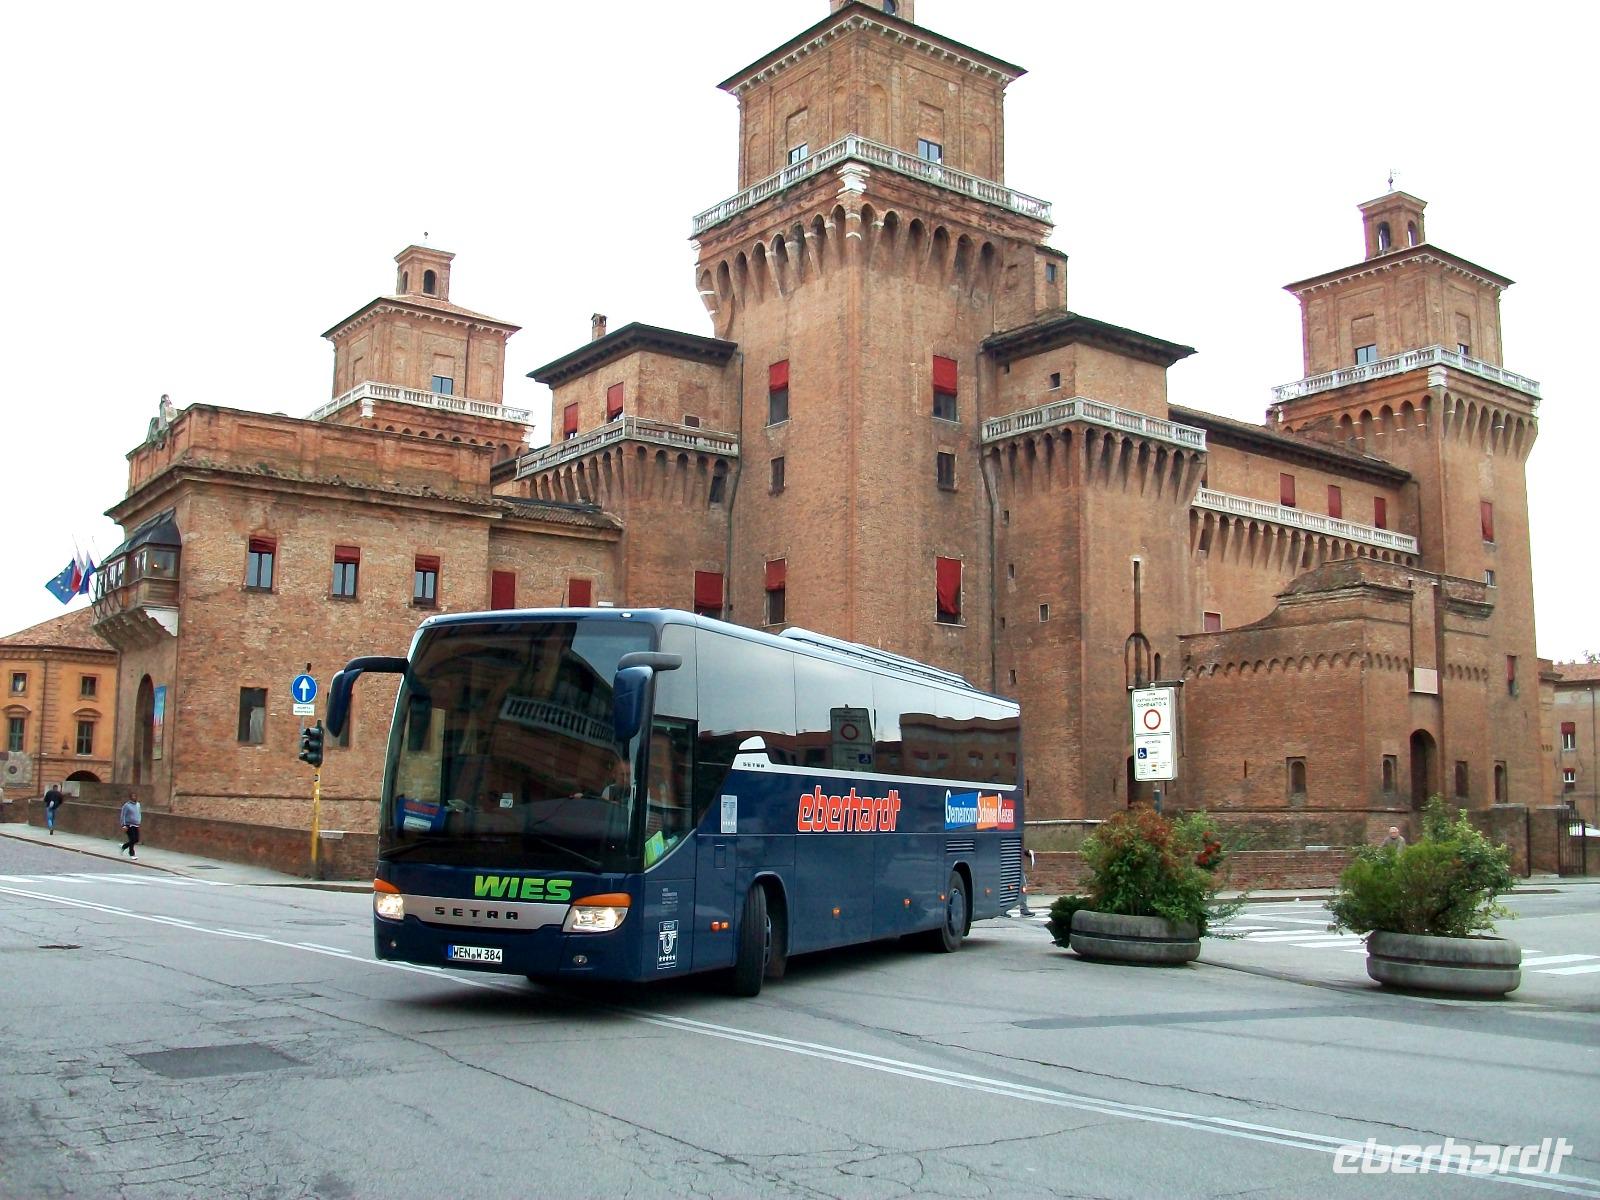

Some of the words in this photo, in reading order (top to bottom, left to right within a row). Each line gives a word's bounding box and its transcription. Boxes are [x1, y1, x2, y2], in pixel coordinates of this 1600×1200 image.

[798, 785, 901, 832] eberhardt
[997, 793, 1014, 823] Reisen
[474, 875, 573, 901] WIES
[434, 906, 519, 920] SETRA
[484, 949, 501, 961] 384
